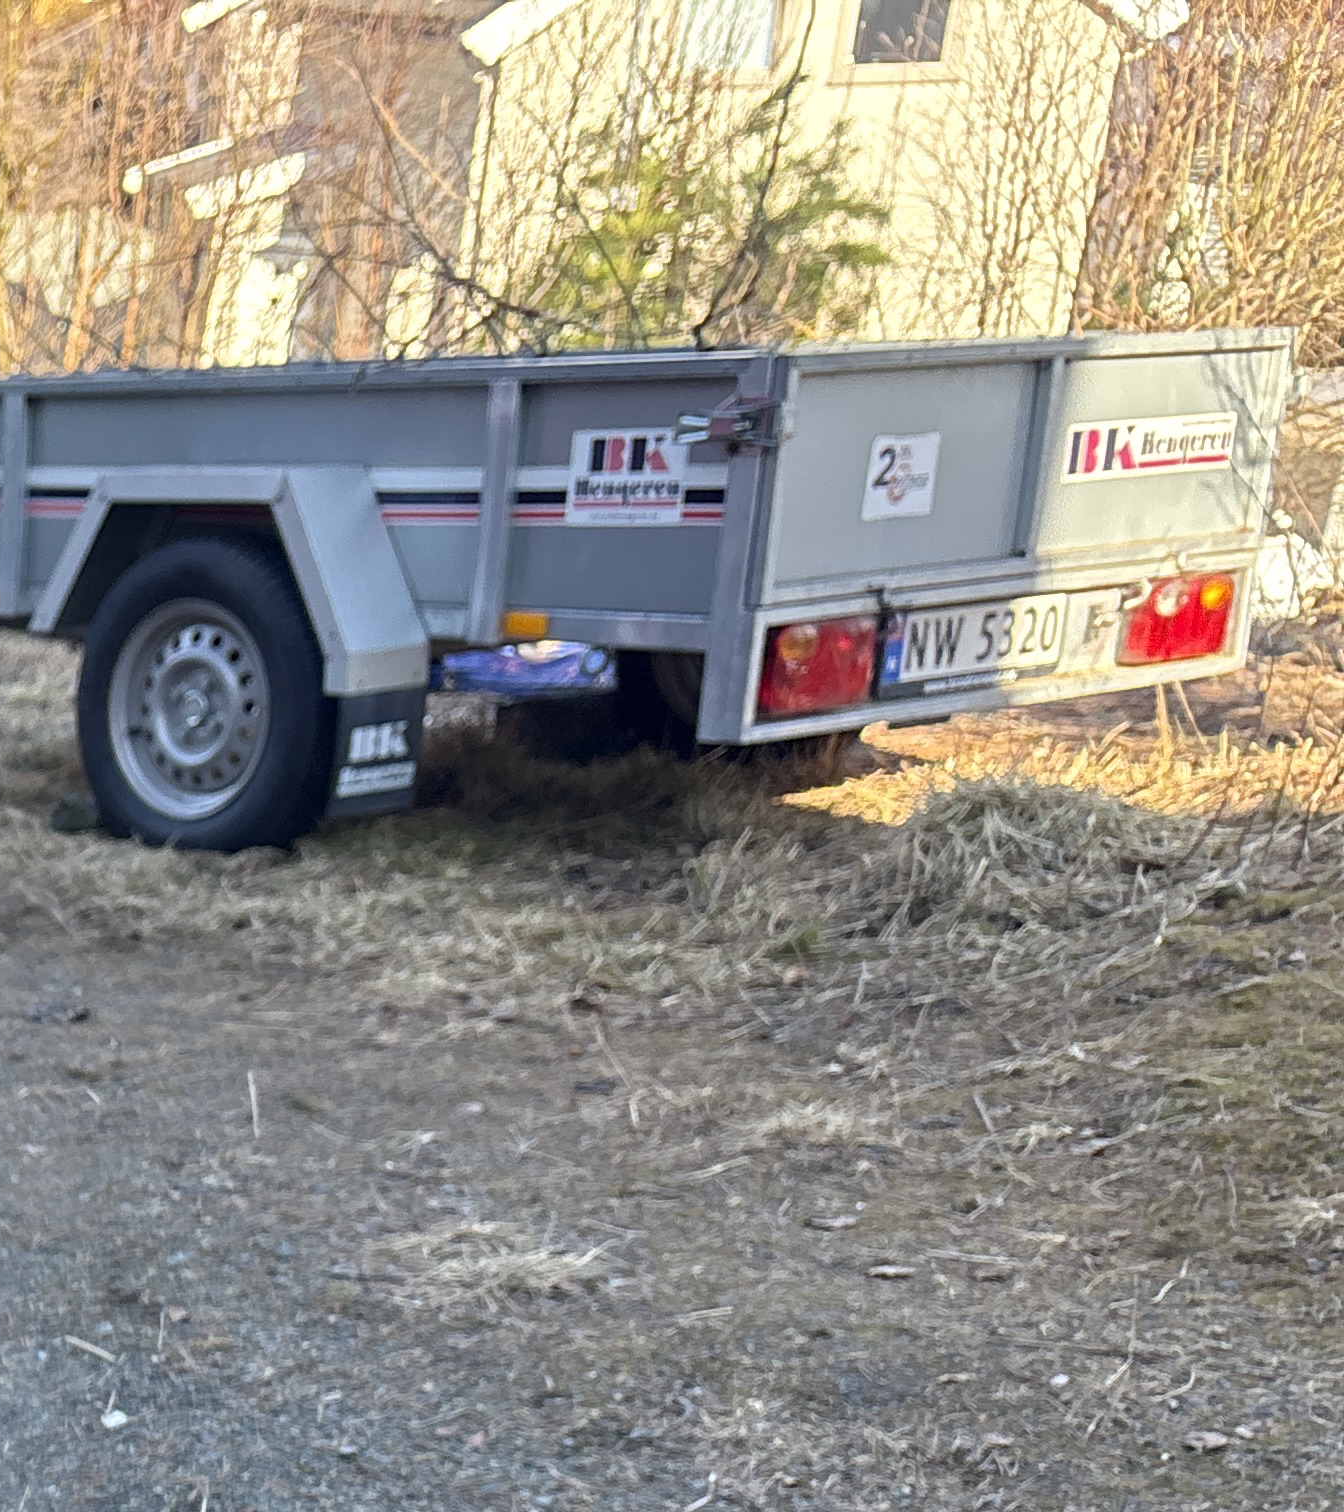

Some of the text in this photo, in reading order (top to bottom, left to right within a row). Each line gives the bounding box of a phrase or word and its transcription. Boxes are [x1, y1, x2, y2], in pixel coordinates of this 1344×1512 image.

[591, 434, 669, 472] BK
[872, 446, 897, 488] 2
[1068, 425, 1137, 474] BK
[904, 604, 1059, 672] NW 5320
